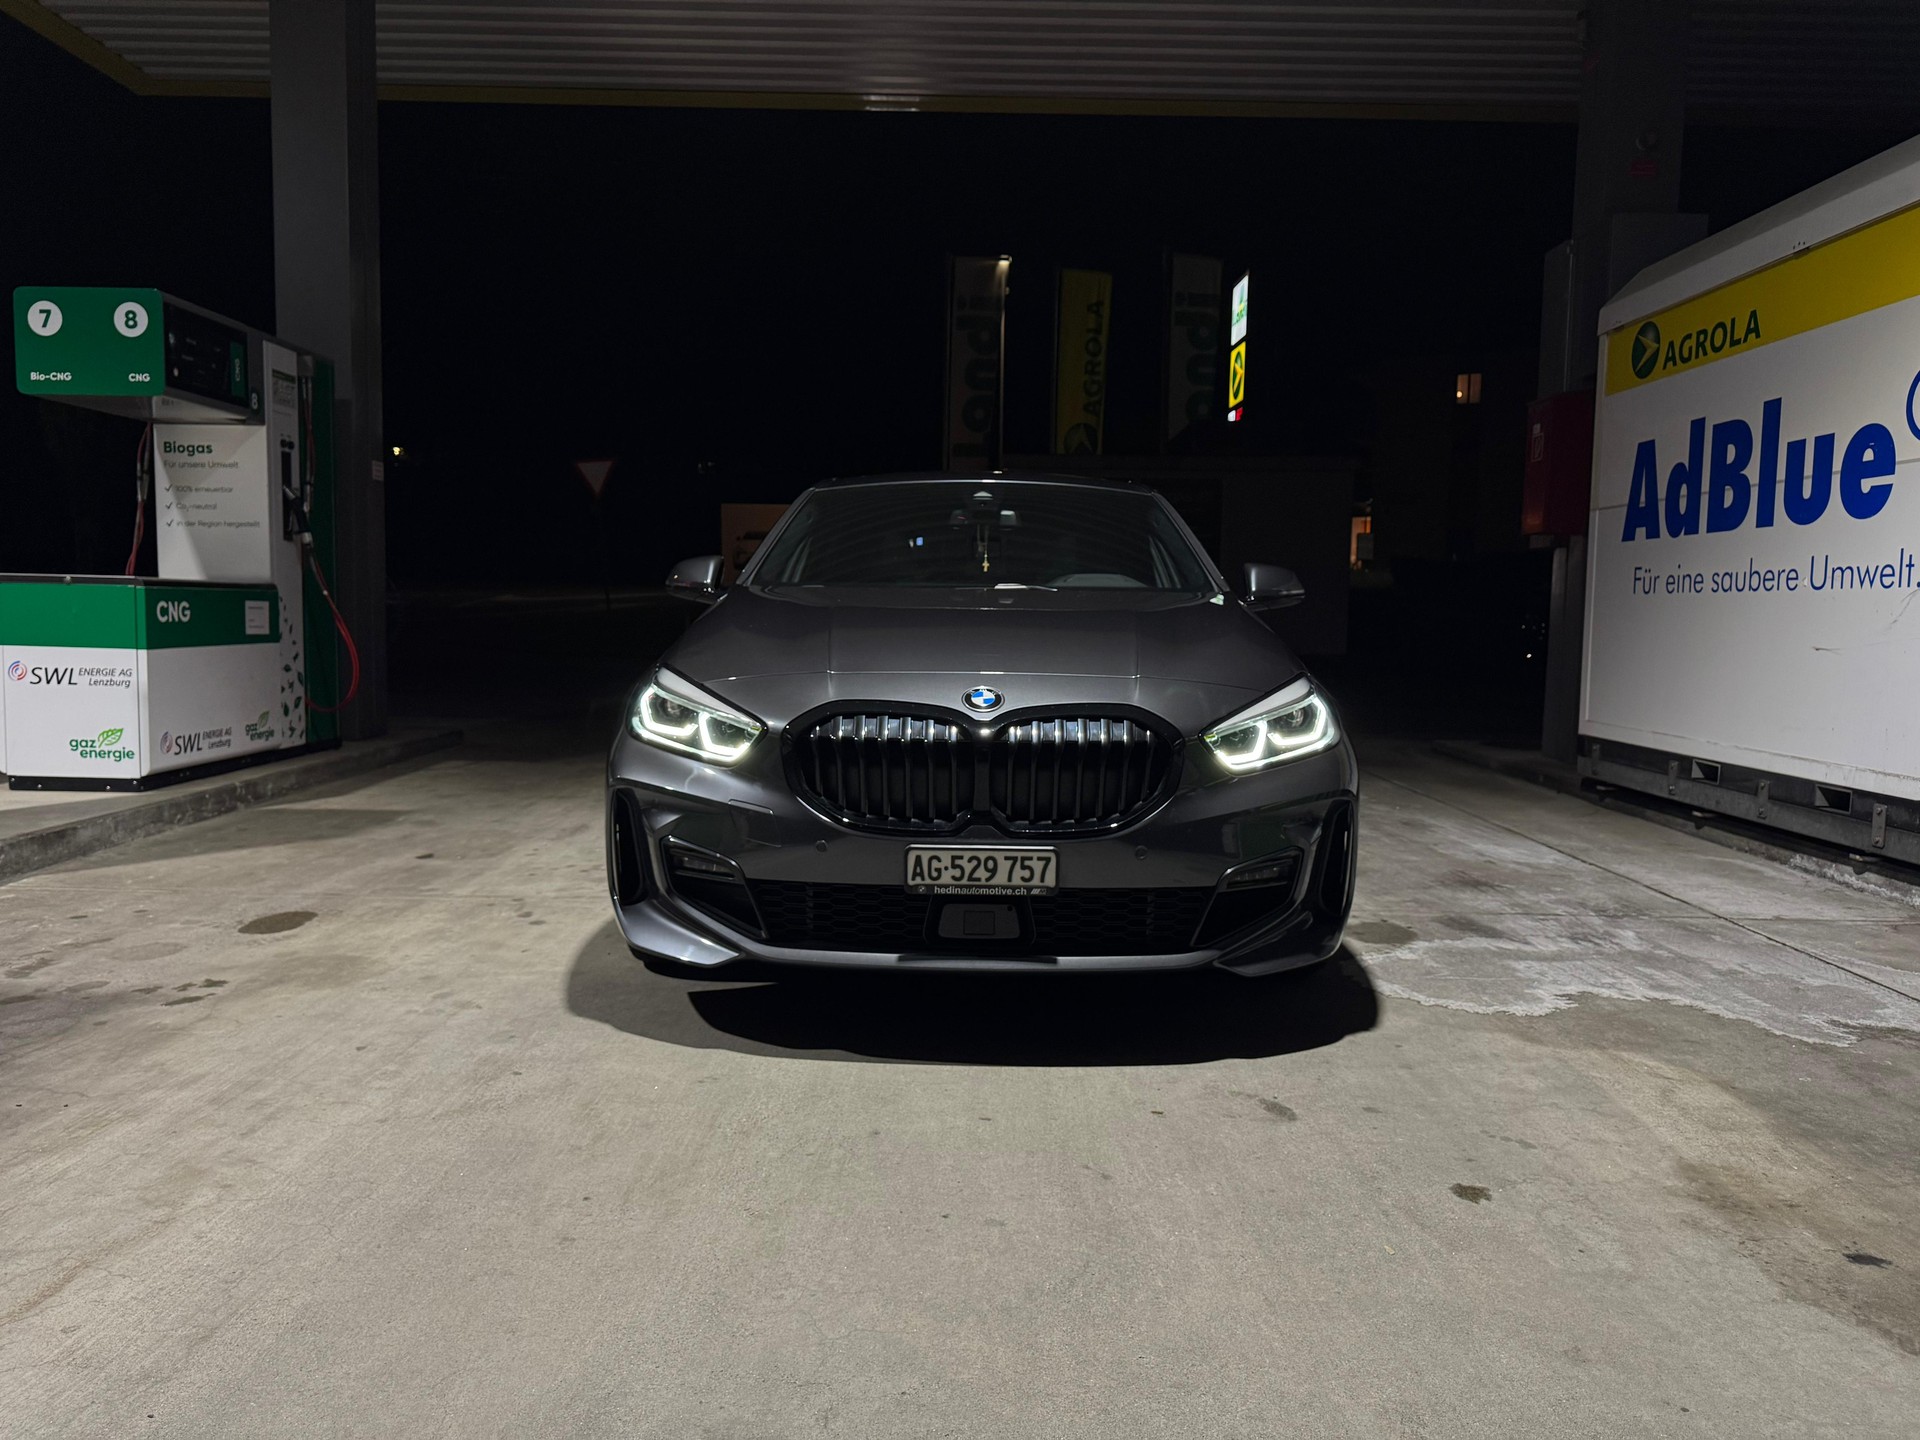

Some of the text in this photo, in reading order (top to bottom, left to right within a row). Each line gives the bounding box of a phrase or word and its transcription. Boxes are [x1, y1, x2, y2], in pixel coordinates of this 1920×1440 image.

[39, 309, 51, 328] 7
[124, 310, 138, 329] 8
[1662, 309, 1761, 370] AGROLA
[1083, 300, 1105, 418] AGROLA
[1173, 290, 1219, 422] andi
[30, 371, 72, 382] Bio-CNG
[128, 372, 151, 383] CNG
[163, 441, 213, 457] Biogas
[1621, 397, 1896, 542] AdBlue
[1633, 566, 1660, 595] Für
[1665, 564, 1704, 594] eine
[1711, 557, 1799, 593] saubere
[156, 601, 191, 623] CNG
[30, 666, 133, 685] SWL ENERGIE AG
[89, 679, 131, 688] Lenzburg
[174, 732, 202, 755] SWL
[249, 727, 275, 742] energie
[69, 738, 97, 751] gaz
[80, 747, 135, 762] energie
[1004, 855, 1052, 883] 757
[934, 885, 1028, 896] hedinautomotive.ch
